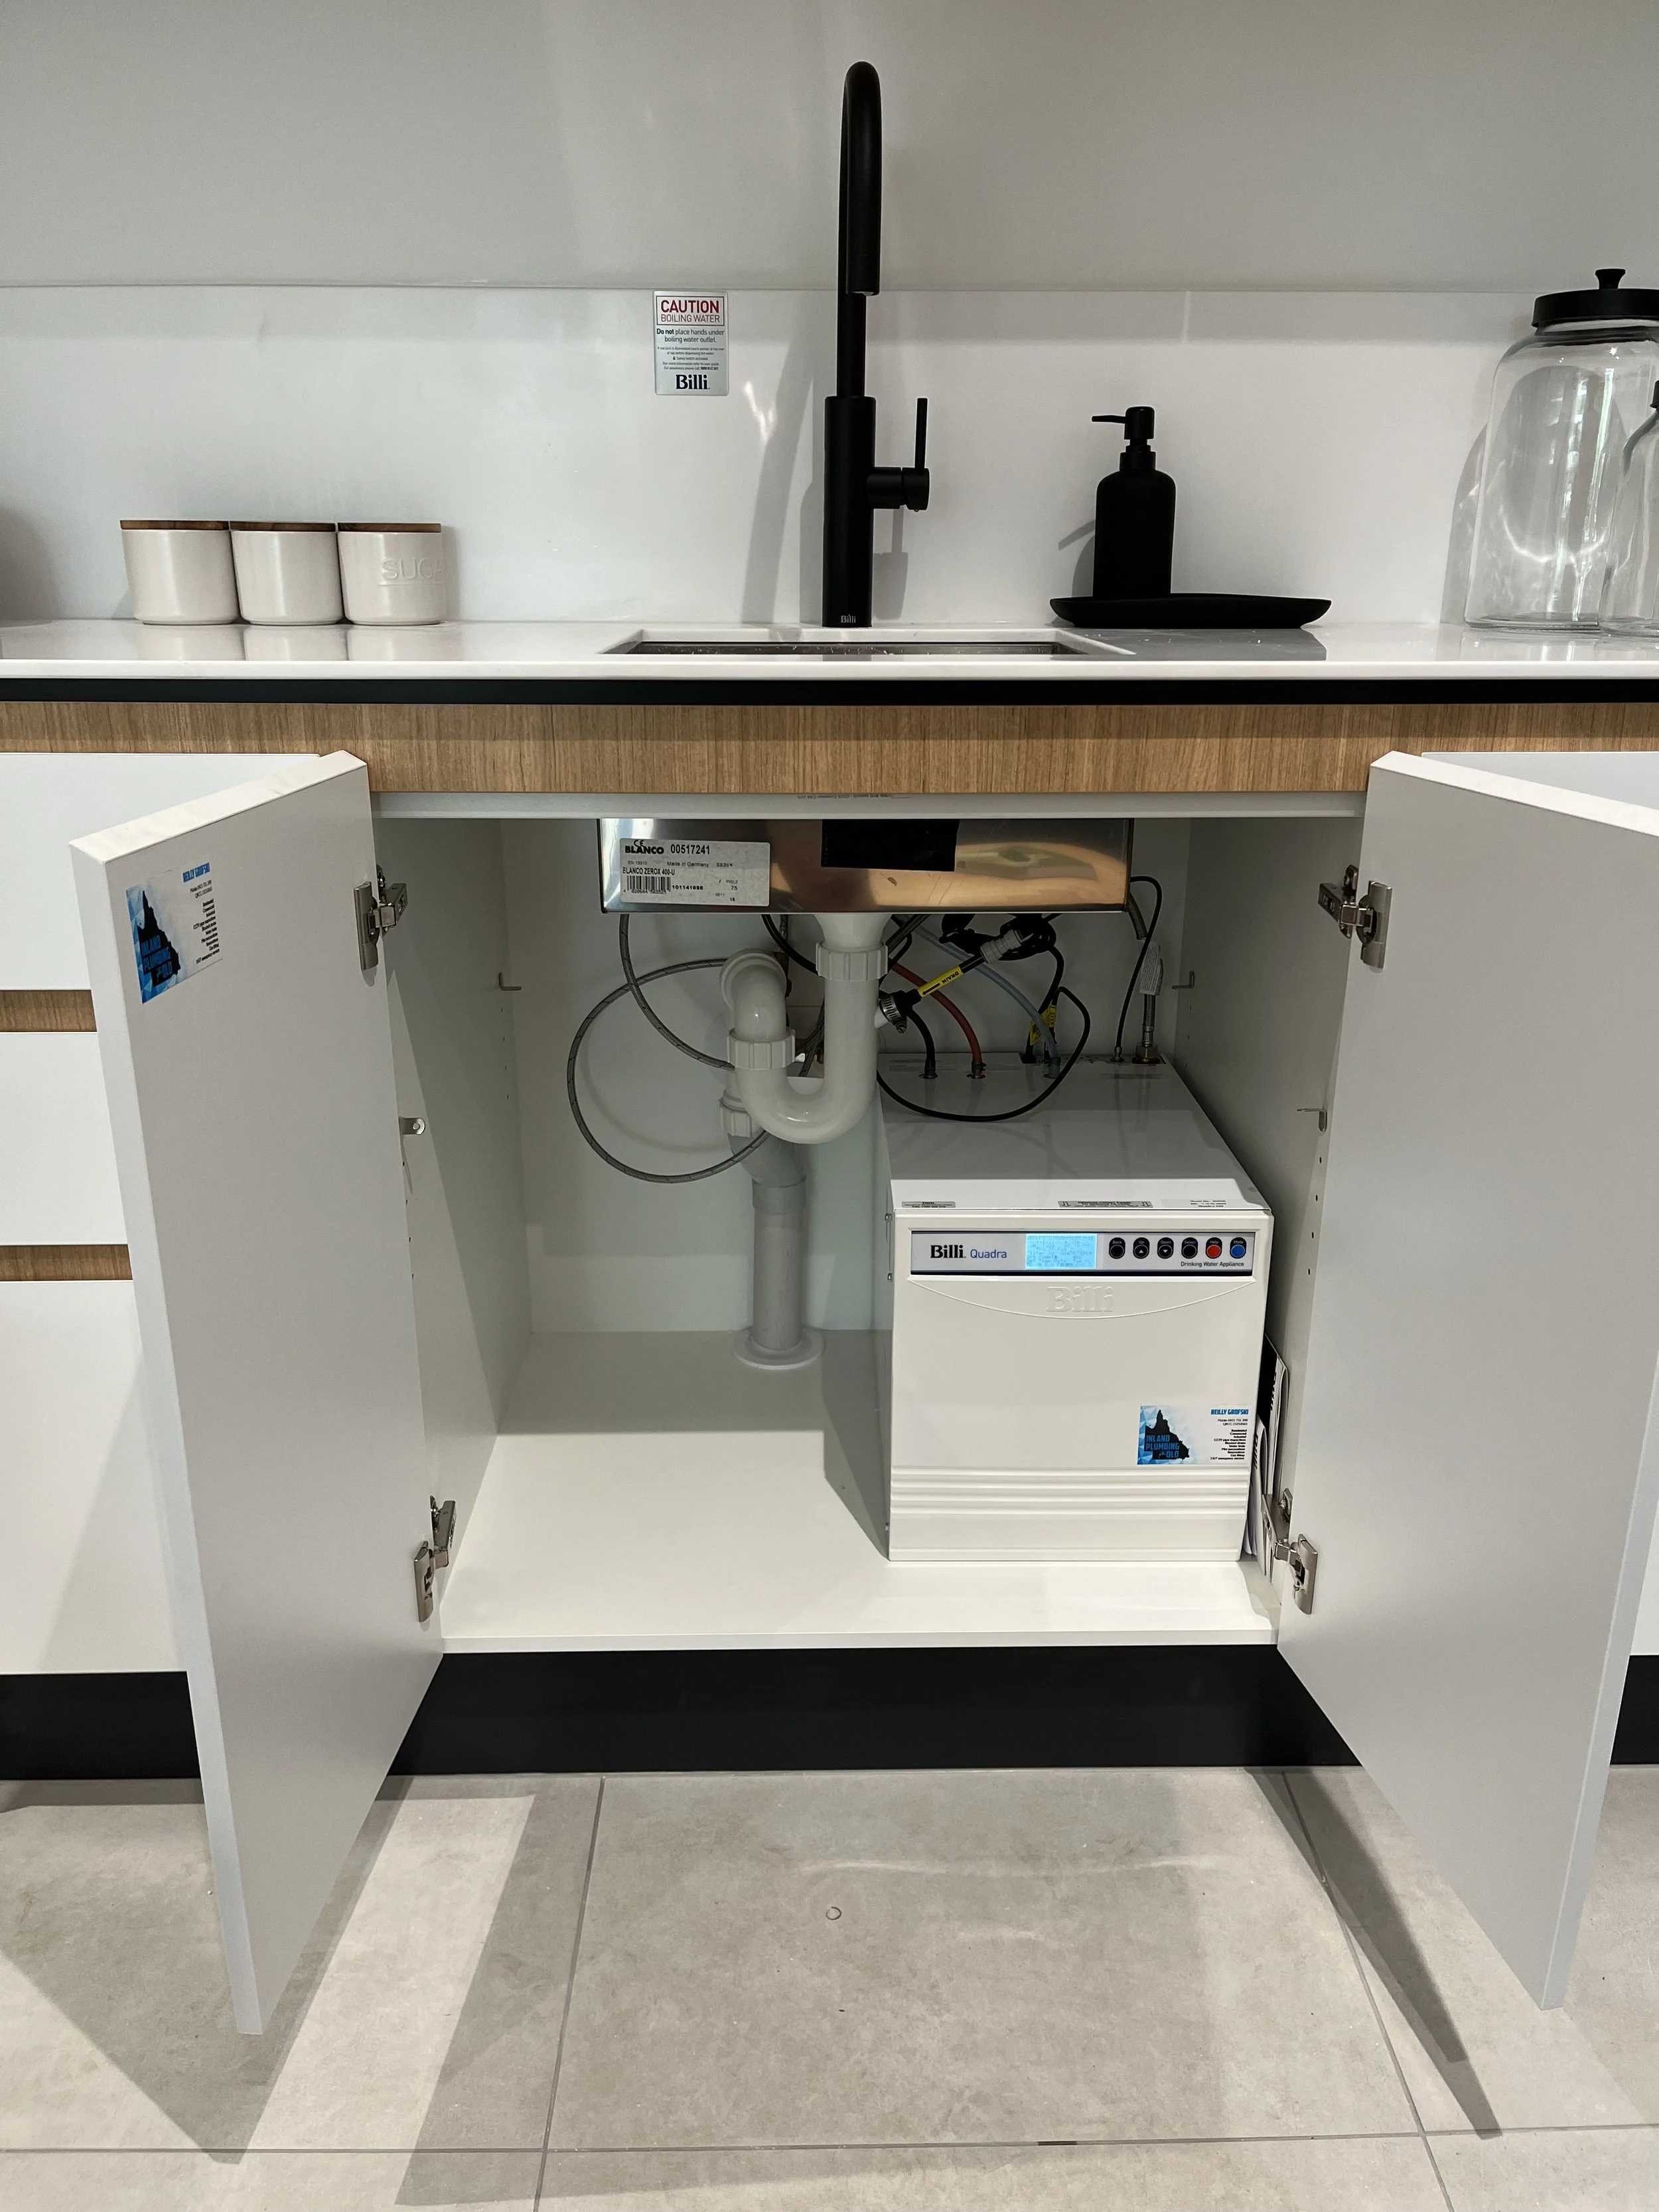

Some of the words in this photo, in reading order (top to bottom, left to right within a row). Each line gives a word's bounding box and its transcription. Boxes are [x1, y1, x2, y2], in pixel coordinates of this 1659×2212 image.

[661, 300, 719, 313] CAUTION
[661, 314, 691, 323] BOILING
[693, 315, 720, 323] WATER
[676, 374, 708, 390] Billi
[841, 614, 856, 623] Billi
[624, 846, 664, 855] BLANCO
[670, 844, 710, 855] 00517241
[942, 971, 960, 984] DRAIN
[930, 1244, 964, 1259] Billi
[970, 1249, 1007, 1259] Quadra
[1046, 1286, 1114, 1312] Billi
